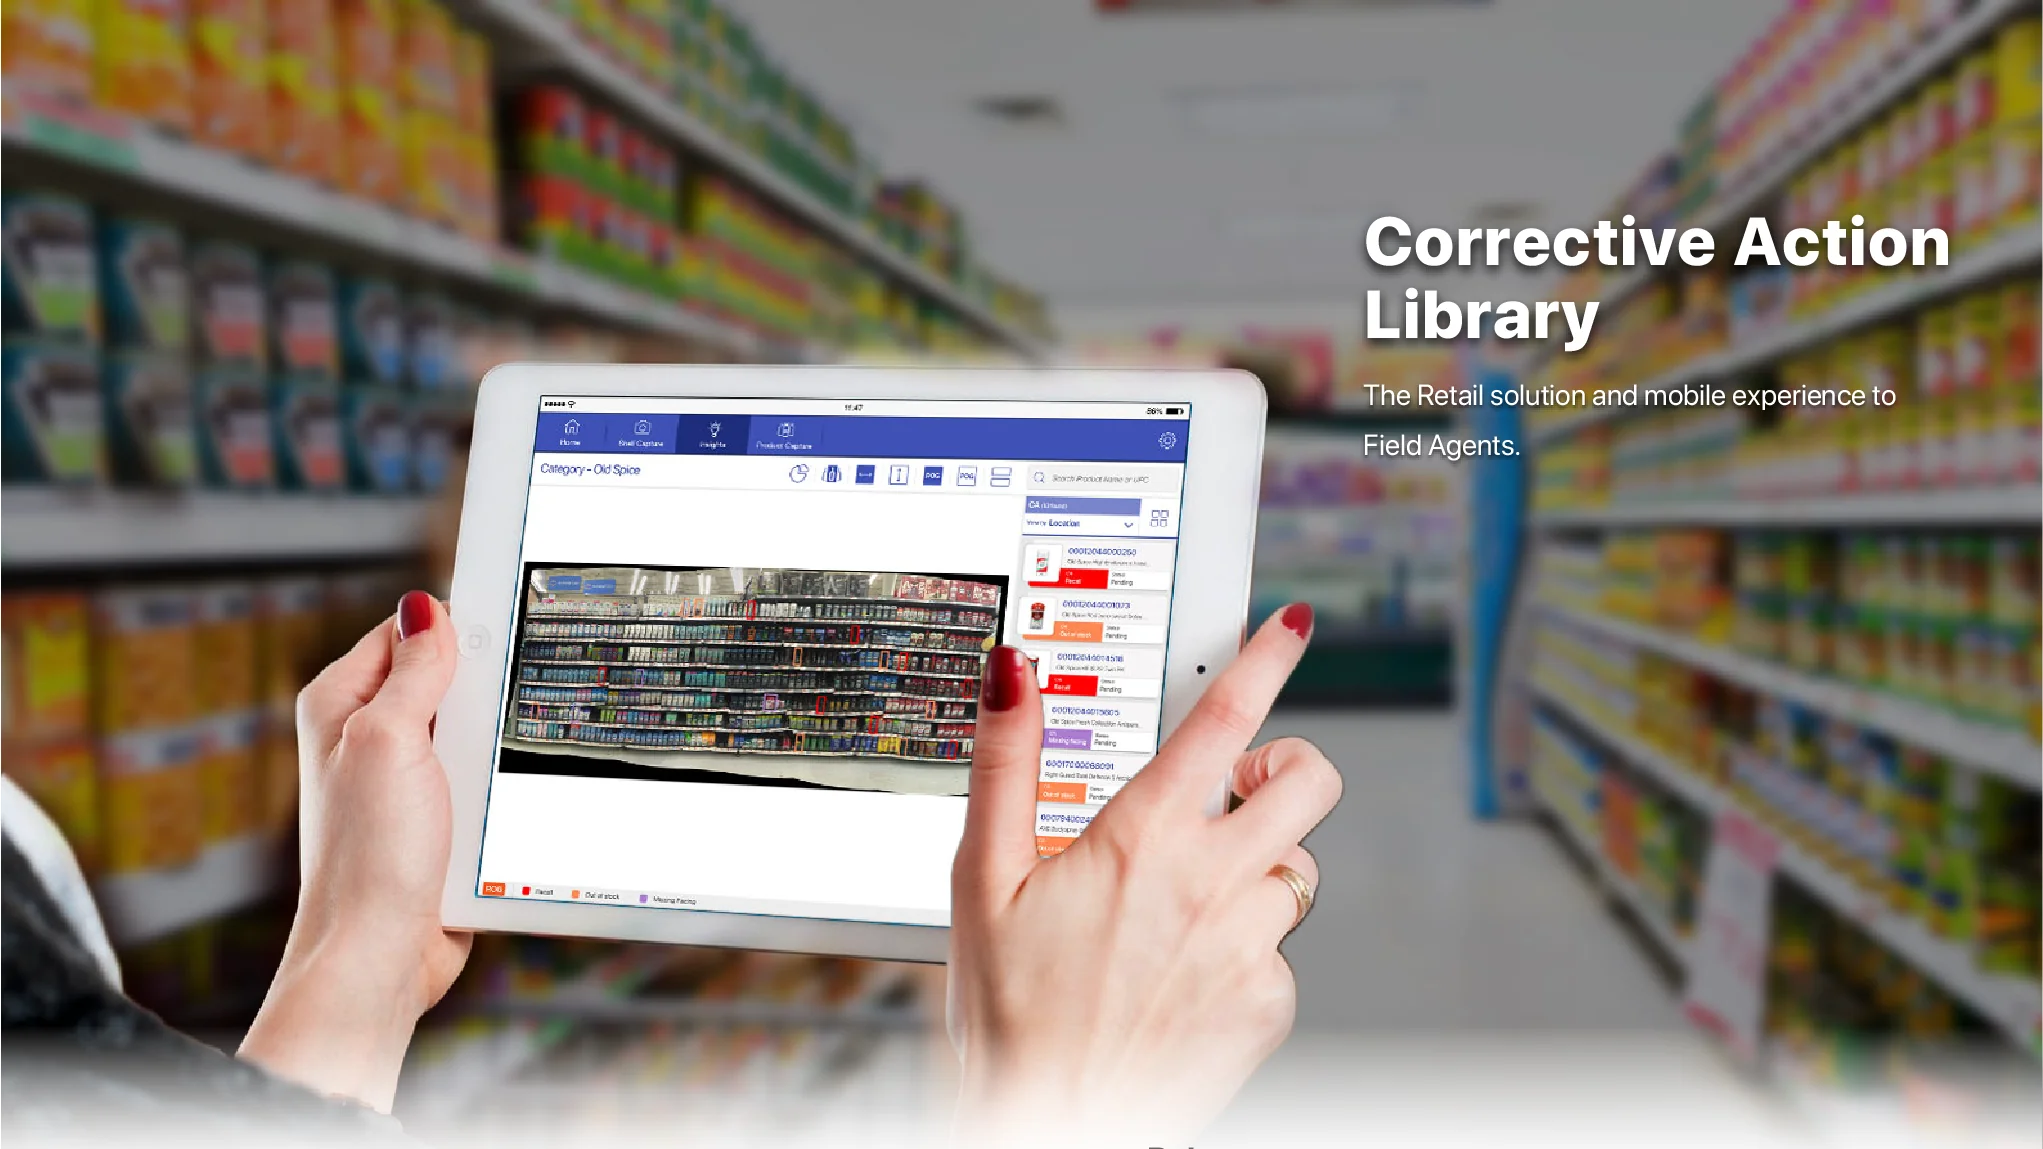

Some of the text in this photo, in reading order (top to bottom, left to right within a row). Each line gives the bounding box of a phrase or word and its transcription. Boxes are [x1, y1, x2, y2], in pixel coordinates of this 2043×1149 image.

[636, 440, 664, 448] Capture
[699, 440, 726, 449] Insights
[784, 442, 812, 450] Capture
[540, 463, 586, 477] Category
[594, 464, 611, 474] Old
[612, 464, 641, 477] Spice
[1052, 474, 1075, 482] Search
[1076, 475, 1102, 483] Product
[1133, 476, 1150, 484] UPC
[1048, 518, 1081, 527] Location
[1106, 632, 1128, 640] Pending
[1100, 686, 1122, 694] Pending
[1094, 738, 1117, 748] Pending
[535, 888, 554, 896] Recall
